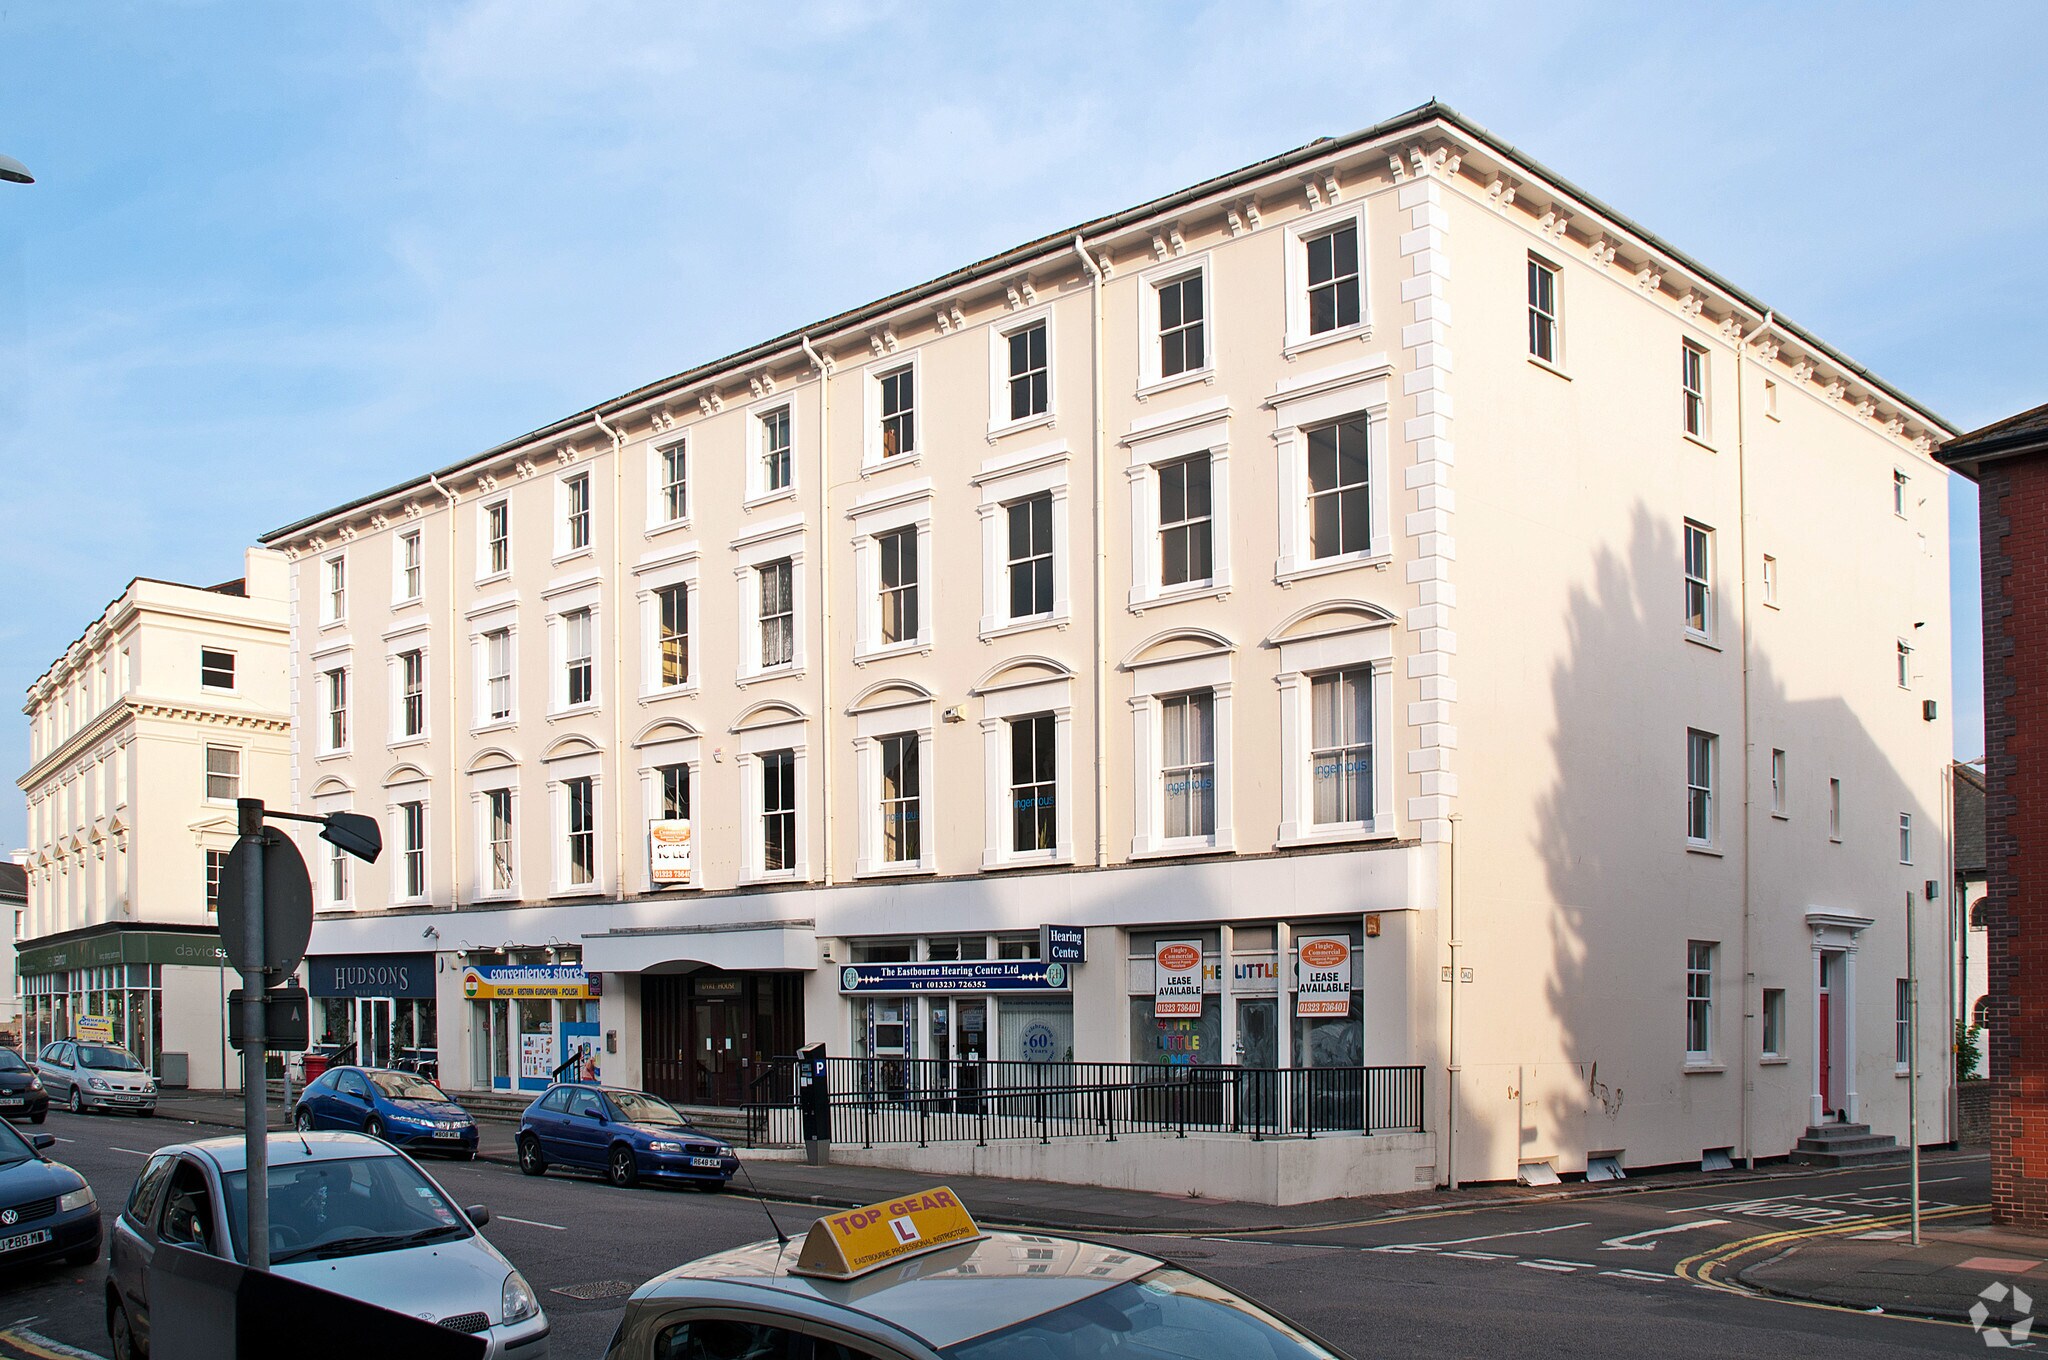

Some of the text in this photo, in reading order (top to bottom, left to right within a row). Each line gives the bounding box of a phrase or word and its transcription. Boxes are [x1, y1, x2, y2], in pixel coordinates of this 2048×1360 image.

[1315, 760, 1368, 779] ingenous
[1014, 796, 1054, 811] ingenous
[1050, 930, 1082, 946] Hearing
[1052, 946, 1079, 958] Centre
[334, 966, 408, 990] HUDSONS
[490, 966, 586, 980] convenience stores
[881, 965, 1020, 977] The Eastbourne Hearing Centre Ltd
[1203, 963, 1278, 980] HE LITTLE
[1310, 972, 1338, 982] LEASE
[1168, 976, 1192, 986] LEASE
[1300, 983, 1350, 993] AVAILABLE
[1159, 986, 1201, 996] AVAILABLE
[1158, 1004, 1199, 1013] 01323 736401
[1300, 1002, 1346, 1012] 01323 736401
[82, 1016, 109, 1024] Squeaky
[1029, 1034, 1048, 1048] 60
[1157, 1034, 1200, 1050] LITTLE
[816, 1062, 824, 1074] P
[834, 1192, 956, 1236] TOP GEAR
[894, 1221, 916, 1241] L
[854, 1226, 970, 1264] EASTBOURNE PROFESSIONAL INSTRUCTORS
